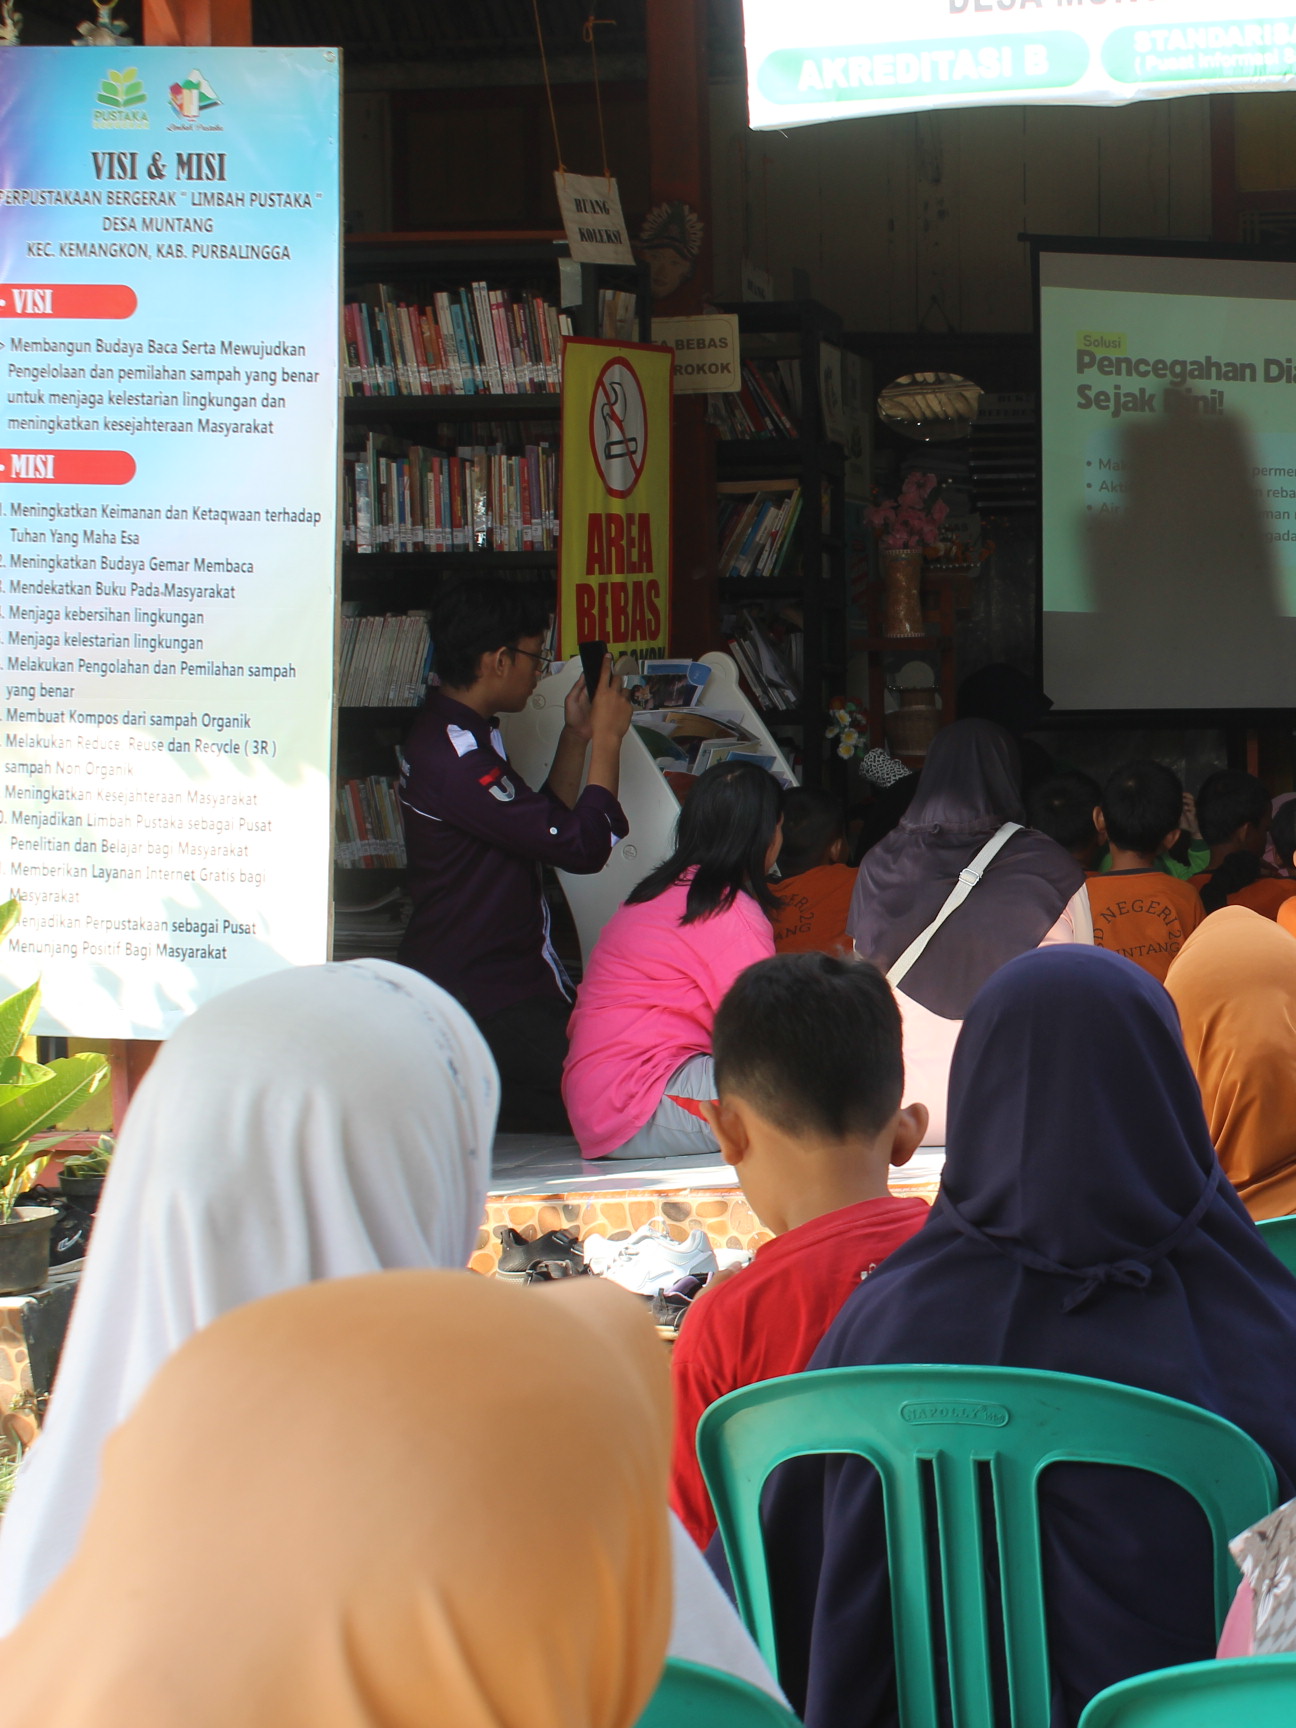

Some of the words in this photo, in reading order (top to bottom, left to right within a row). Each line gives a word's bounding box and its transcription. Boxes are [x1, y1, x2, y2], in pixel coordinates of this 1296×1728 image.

[799, 46, 1012, 91] AKREDITASI
[1024, 44, 1049, 76] B
[93, 110, 148, 122] PUSTAKA
[92, 152, 138, 180] VISI
[147, 152, 167, 180] &
[176, 152, 227, 181] MISI
[107, 191, 177, 207] BERGERAK
[191, 192, 245, 208] LIMBAH
[249, 193, 312, 208] PUSTAKA
[574, 198, 610, 215] RUANG
[103, 217, 137, 232] DESA
[141, 217, 213, 233] MUNTANG
[578, 227, 623, 244] KOLEKSI
[27, 242, 54, 257] KEC.
[60, 243, 152, 259] KEMANGKON,
[156, 244, 188, 258] KAB.
[192, 244, 291, 260] PURBALINGGA
[12, 289, 53, 314] VISI
[11, 338, 91, 357] Membangun
[96, 339, 143, 358] Budaya
[148, 340, 177, 354] Baca
[183, 340, 215, 355] Serta
[220, 341, 305, 360] Mewujudkan
[675, 337, 728, 350] BEBAS
[1083, 334, 1121, 350] Solusi
[8, 364, 85, 383] Pengelolaan
[90, 365, 113, 379] dan
[118, 365, 186, 384] pemilahan
[190, 366, 240, 385] sampah
[245, 370, 277, 386] yang
[282, 368, 319, 383] benar
[674, 362, 731, 375] ROKOK
[1076, 349, 1257, 384] Pencegahan
[8, 389, 44, 404] untuk
[49, 390, 103, 409] menjaga
[108, 391, 178, 406] kelestarian
[183, 392, 256, 411] lingkungan
[261, 393, 286, 408] dan
[1076, 384, 1156, 418] Sejak
[8, 415, 99, 434] meningkatkan
[104, 417, 193, 436] kesejahteraan
[198, 418, 273, 437] Masyarakat
[10, 454, 54, 479] MISI
[10, 503, 97, 522] Meningkatkan
[101, 504, 161, 520] Keimanan
[165, 505, 188, 520] dan
[193, 506, 261, 525] Ketaqwaan
[265, 507, 321, 526] terhadap
[10, 528, 46, 543] Tuhan
[51, 529, 78, 547] Yang
[83, 530, 116, 544] Maha
[121, 530, 139, 545] Esa
[586, 512, 653, 576] AREA
[10, 554, 97, 574] Meningkatkan
[101, 556, 145, 574] Budaya
[149, 557, 189, 572] Gemar
[194, 558, 253, 573] Membaca
[10, 580, 91, 596] Mendekatkan
[96, 581, 126, 596] Buku
[164, 583, 235, 602] Masyarakat
[9, 606, 60, 624] Menjaga
[65, 607, 130, 622] kebersihan
[134, 608, 204, 627] lingkungan
[576, 579, 661, 645] BEBAS
[9, 631, 60, 650] Menjaga
[64, 632, 129, 648] kelestarian
[134, 634, 203, 653] lingkungan
[8, 657, 74, 673] Melakukan
[78, 659, 149, 678] Pengolahan
[154, 660, 176, 675] dan
[181, 661, 244, 676] Pemilahan
[248, 662, 296, 681] sampah
[6, 686, 35, 701] yang
[40, 683, 74, 698] benar
[7, 708, 64, 724] Membuat
[69, 710, 118, 729] Kompos
[123, 711, 146, 726] dari
[150, 712, 198, 731] sampah
[202, 713, 250, 732] Organik
[6, 734, 72, 750] Melakukan
[168, 738, 190, 753] dan
[195, 739, 240, 757] Recycle
[5, 760, 51, 778] sampah
[5, 785, 92, 805] Meningkatkan
[12, 811, 82, 830] Menjadikan
[11, 836, 70, 852] Penelitian
[75, 838, 97, 853] dan
[11, 862, 87, 878] Memberikan
[92, 864, 141, 883] Layanan
[172, 918, 219, 937] sebagai
[223, 919, 256, 935] Pusat
[1100, 899, 1178, 926] NEGERI
[1168, 929, 1182, 939] 2
[156, 943, 227, 962] Masyarakat
